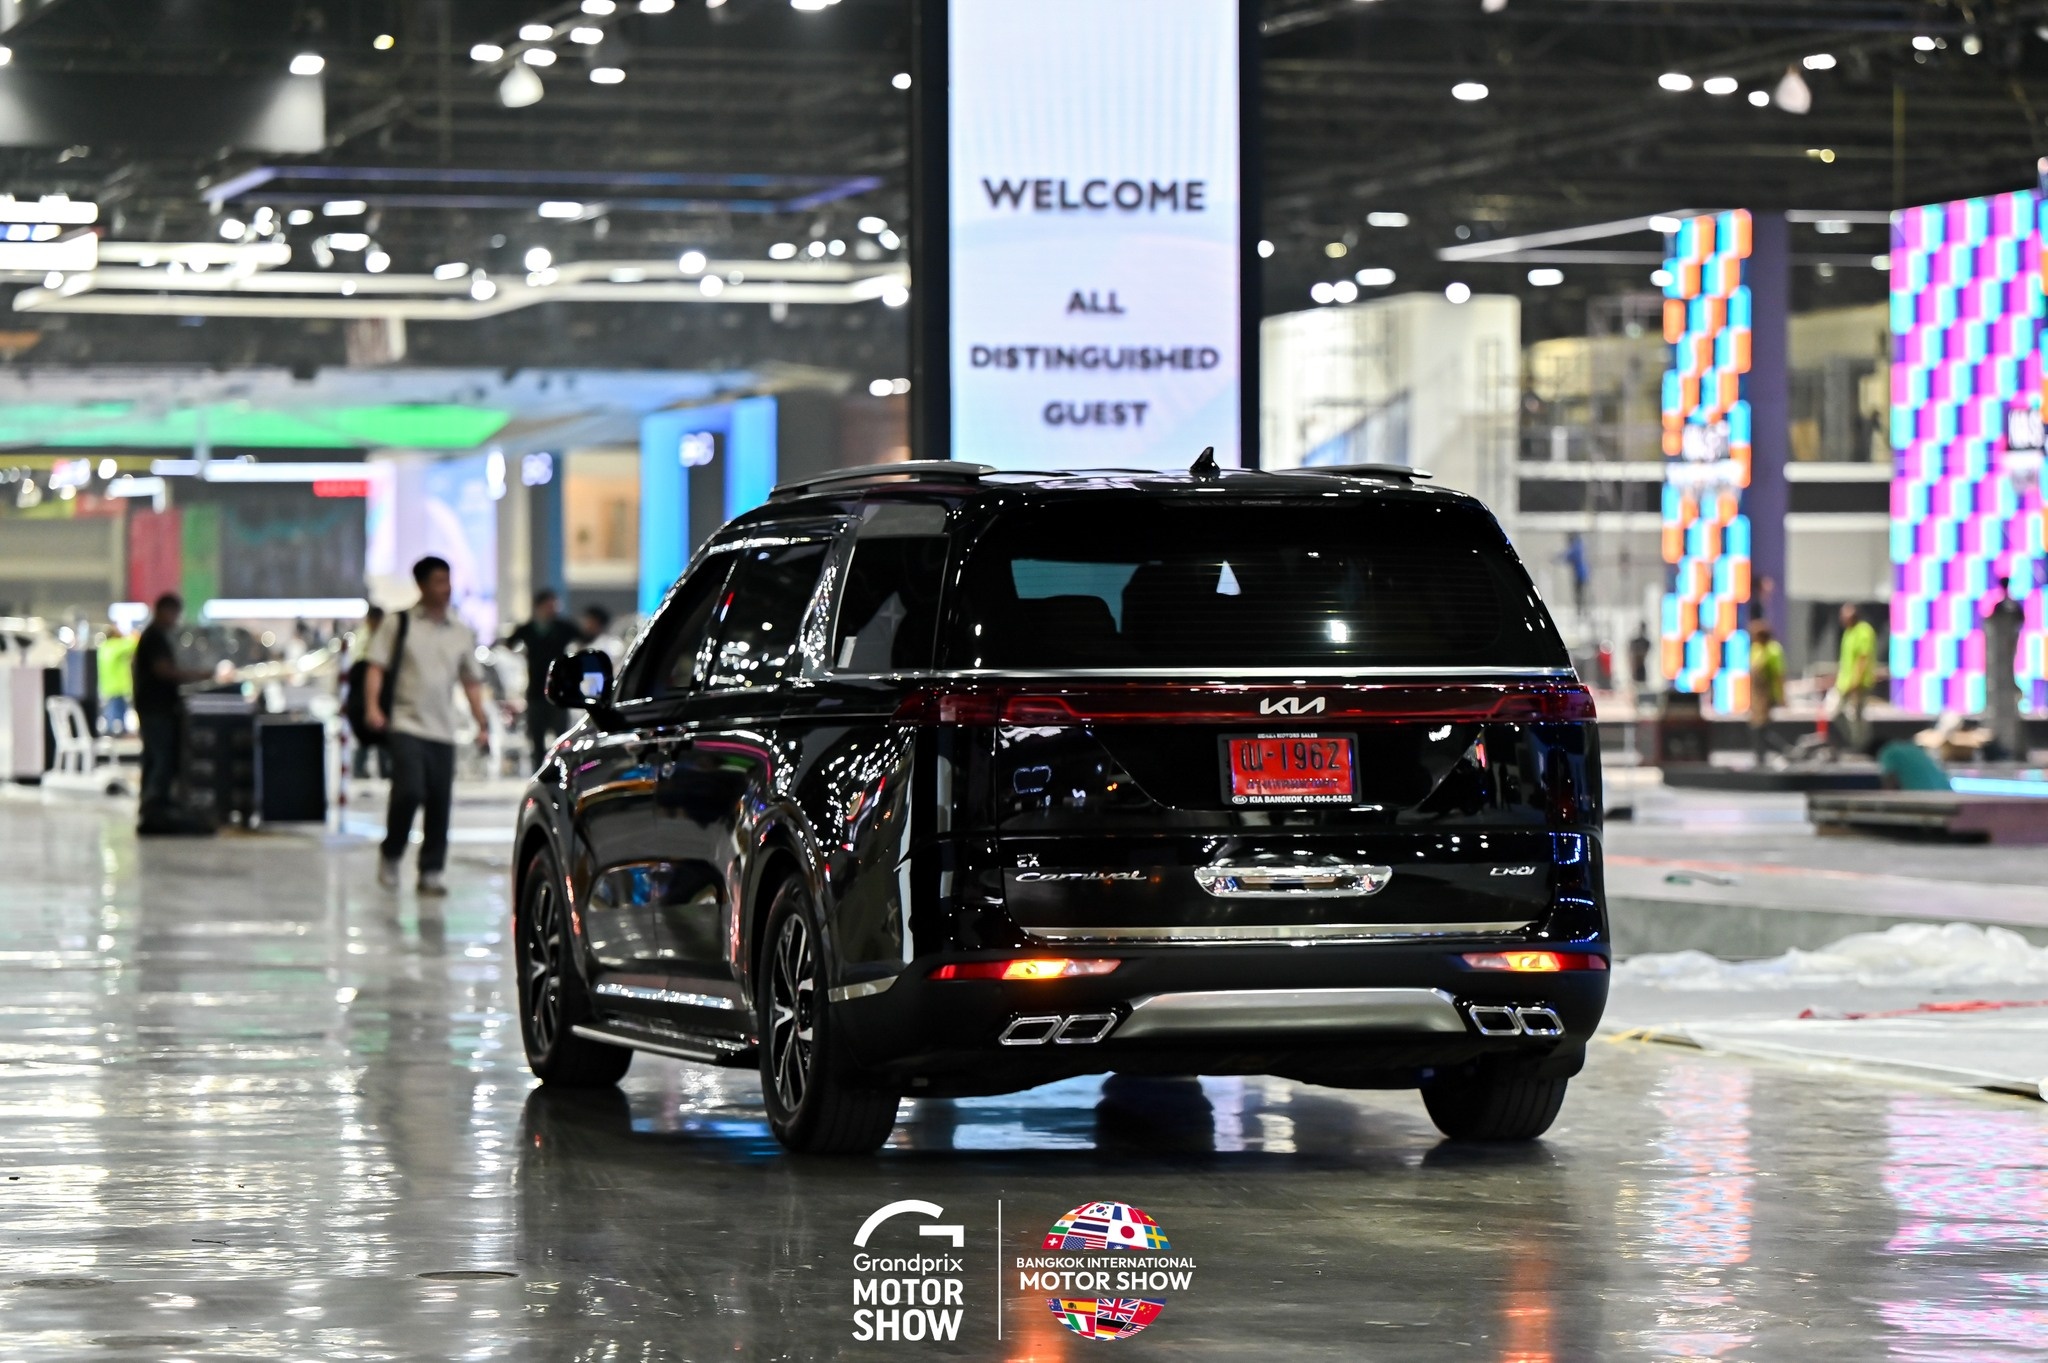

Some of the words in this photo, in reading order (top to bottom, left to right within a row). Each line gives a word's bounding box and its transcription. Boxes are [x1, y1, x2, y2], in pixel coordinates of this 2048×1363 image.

[983, 179, 1206, 212] WELCOME
[1066, 288, 1125, 314] ALL
[971, 346, 1219, 370] DISTINGUISHED
[1043, 401, 1149, 426] GUEST
[1260, 696, 1326, 715] KIA
[1249, 795, 1263, 804] KIA
[1264, 795, 1303, 804] BANGKOK
[1015, 870, 1148, 882] Carnival
